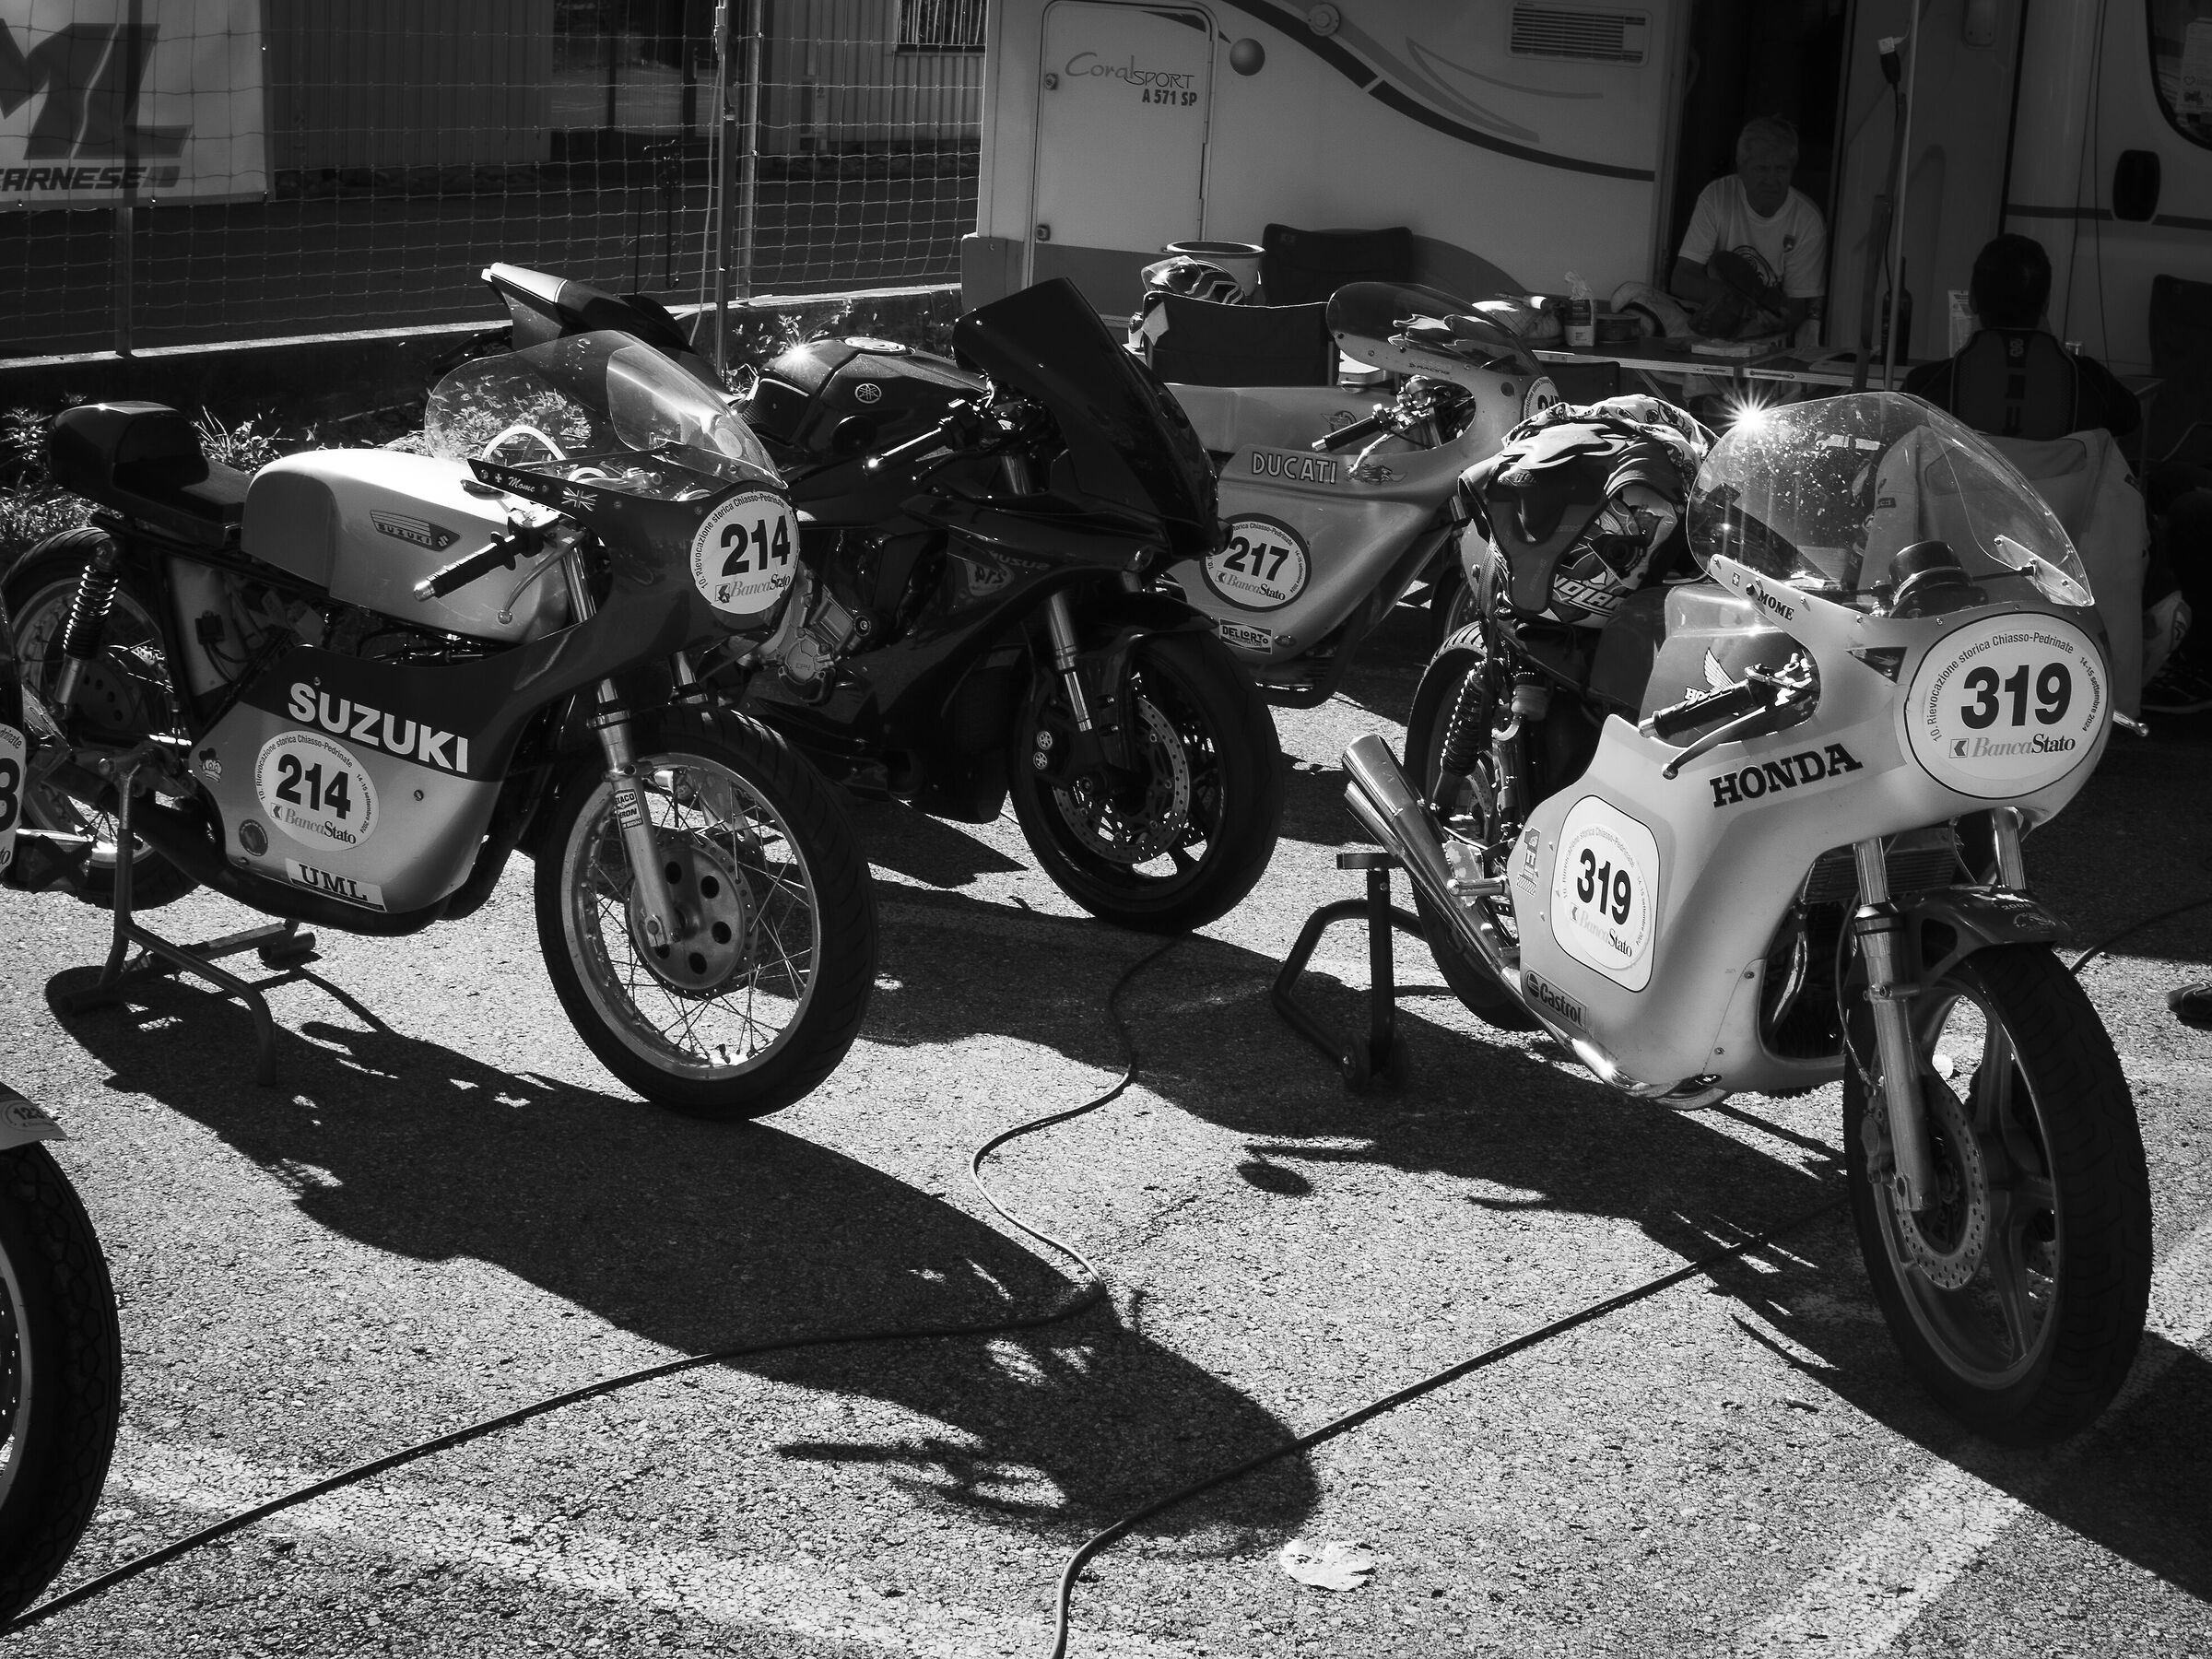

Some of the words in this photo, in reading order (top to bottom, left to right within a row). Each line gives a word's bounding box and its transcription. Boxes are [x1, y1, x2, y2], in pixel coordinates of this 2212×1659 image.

[1065, 51, 1135, 79] Coral
[1124, 70, 1195, 89] SPORT
[1142, 88, 1151, 103] A
[1153, 88, 1177, 105] 571
[1181, 91, 1198, 106] SP
[0, 166, 147, 192] ARNESE
[508, 476, 536, 493] Mome
[1252, 451, 1337, 486] DUCATI
[377, 524, 433, 547] SUZUKI
[694, 522, 714, 577] Rievocazione
[712, 503, 735, 524] storica
[720, 515, 791, 578] 214
[1222, 535, 1290, 582] 217
[1227, 572, 1286, 601] BancaStato
[1757, 591, 1794, 622] MOME
[1927, 660, 1959, 725] Rievocazione
[1958, 641, 1991, 664] storica
[1992, 631, 2074, 654] Chiasso-Pedrinate
[2079, 656, 2095, 677] 14-15
[1960, 662, 2072, 729] 319
[2090, 677, 2100, 715] settembre
[288, 682, 469, 774] SUZUKI
[2082, 714, 2095, 732] 2024
[255, 743, 277, 787] Rievocazione
[276, 735, 297, 748] storica
[297, 734, 353, 768] Chiasso-Pedrinate
[1972, 733, 2076, 758] BancaStato
[276, 753, 352, 820] 214
[1709, 743, 1864, 808] HONDA
[285, 806, 357, 845] BancaStato
[299, 864, 369, 901] UML
[1577, 848, 1631, 925] 319
[1580, 910, 1632, 958] BancaStato
[1539, 982, 1584, 1028] Castrol
